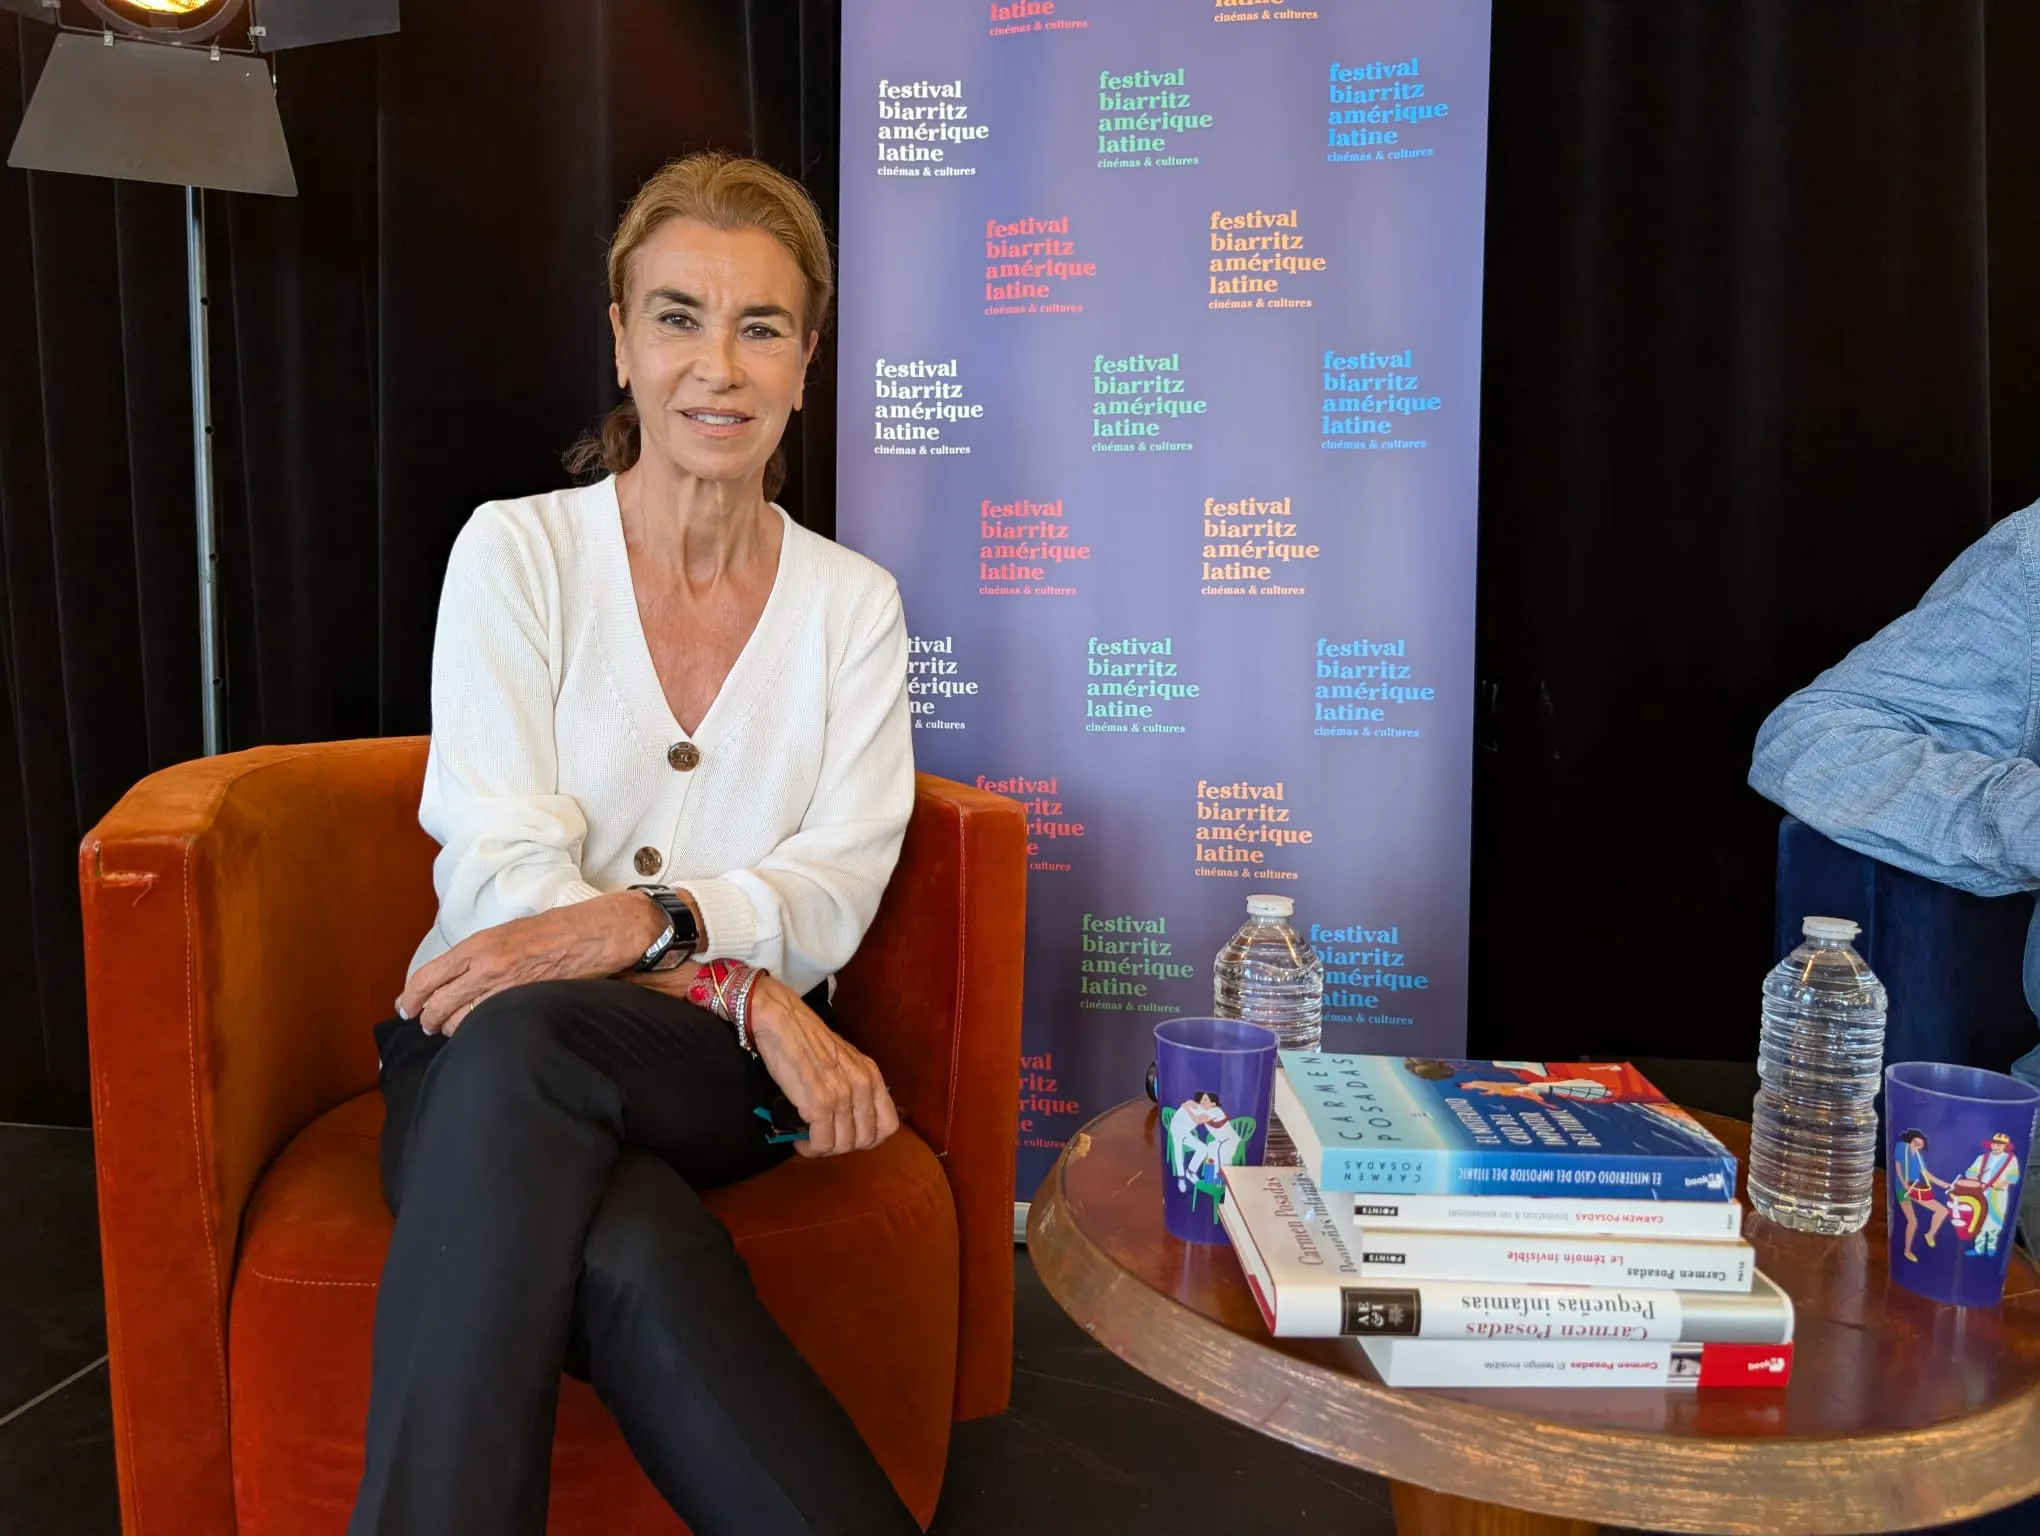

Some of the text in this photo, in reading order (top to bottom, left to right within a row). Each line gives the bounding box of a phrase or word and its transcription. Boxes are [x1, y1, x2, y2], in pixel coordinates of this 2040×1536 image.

[991, 0, 1055, 21] latine
[1214, 9, 1318, 22] cinémas & cultures
[989, 20, 1089, 36] cinémas & cultures
[1099, 67, 1185, 90] festival
[1329, 57, 1419, 83] festival
[878, 79, 963, 100] festival
[1329, 81, 1424, 104] biarritz
[878, 100, 968, 121] biarritz
[1099, 90, 1190, 111] biarritz
[1098, 111, 1213, 133] amérique
[1328, 103, 1449, 125] amérique
[877, 122, 990, 144] amérique
[1328, 127, 1398, 147] latine
[878, 142, 944, 162] latine
[1098, 135, 1165, 154] latine
[1097, 156, 1199, 168] cinémas & cultures
[1327, 148, 1433, 162] cinémas & cultures
[877, 165, 976, 177] cinémas & cultures
[986, 215, 1069, 239] festival
[1209, 208, 1298, 232] festival
[986, 236, 1074, 261] biarritz
[1210, 231, 1304, 252] biarritz
[985, 259, 1097, 283] amérique
[1208, 252, 1327, 276] amérique
[985, 279, 1049, 301] latine
[1209, 275, 1278, 295] latine
[984, 303, 1083, 315] cinémas & cultures
[1207, 297, 1313, 309] cinémas & cultures
[875, 358, 958, 379] festival
[1094, 353, 1180, 374] festival
[1323, 350, 1412, 370] festival
[875, 379, 963, 400] biarritz
[1094, 375, 1185, 395] biarritz
[1323, 371, 1418, 392] biarritz
[874, 401, 984, 423] amérique
[1093, 396, 1207, 418] amérique
[1322, 394, 1441, 416] amérique
[874, 421, 940, 441] latine
[1093, 419, 1160, 437] latine
[1322, 415, 1391, 434] latine
[874, 444, 971, 455] cinémas & cultures
[1091, 441, 1193, 452] cinémas & cultures
[1321, 439, 1427, 449] cinémas & cultures
[980, 499, 1063, 519] festival
[1203, 496, 1292, 518] festival
[980, 519, 1068, 539] biarritz
[1203, 518, 1297, 543] biarritz
[979, 542, 1091, 563] amérique
[1202, 540, 1320, 564] amérique
[979, 562, 1045, 581] latine
[1201, 559, 1272, 581] latine
[979, 585, 1077, 595] cinémas & cultures
[1201, 584, 1305, 596] cinémas & cultures
[907, 635, 953, 654] tival
[1087, 636, 1173, 656] festival
[1316, 637, 1405, 658] festival
[907, 656, 958, 675] rritz
[1087, 657, 1178, 678] biarritz
[1316, 659, 1411, 680] biarritz
[907, 676, 979, 698] érique
[1086, 678, 1200, 701] amérique
[1314, 679, 1436, 705] amérique
[1086, 699, 1153, 718] latine
[1314, 702, 1385, 722] latine
[914, 718, 967, 730] & cultures
[1085, 722, 1186, 734] cinémas & cultures
[1313, 726, 1420, 738] cinémas & cultures
[975, 774, 1059, 795] festival
[1196, 779, 1284, 801] festival
[1196, 801, 1289, 822] biarritz
[1195, 823, 1313, 847] amérique
[1195, 843, 1264, 864] latine
[1029, 860, 1072, 872] cultures
[1194, 866, 1298, 880] cinémas & cultures
[1082, 912, 1166, 935] festival
[1310, 922, 1399, 945] festival
[1082, 933, 1172, 956] biarritz
[1081, 957, 1194, 980] amérique
[1081, 976, 1147, 997] latine
[1325, 967, 1429, 992] mérique
[1080, 1001, 1182, 1015] cinémas & cultures
[1321, 989, 1379, 1009] atine
[1367, 1014, 1414, 1026] cultures
[1300, 1057, 1363, 1141] CARMEN
[1332, 1058, 1402, 1141] POSADAS
[1344, 1160, 1423, 1172] POSADAS
[1344, 1173, 1422, 1184] CARMEN
[1458, 1167, 1663, 1186] EL MISTERIOSO CASO DEL IMPOSTOR DEL TITANIC
[1361, 1207, 1396, 1215] POINTS
[1575, 1213, 1664, 1224] CARMEN POSADAS
[1262, 1177, 1324, 1266] Carmen Posadas
[1368, 1254, 1403, 1263] POINTS
[1507, 1251, 1558, 1263] invisible
[1610, 1256, 1624, 1265] Le
[1626, 1268, 1676, 1280] Posadas
[1680, 1269, 1726, 1281] Carmen
[1461, 1294, 1656, 1320] Pequeñas infamias
[1465, 1322, 1649, 1341] Carmen Posadas
[1569, 1361, 1614, 1371] Posadas
[1617, 1361, 1658, 1370] Carmen
